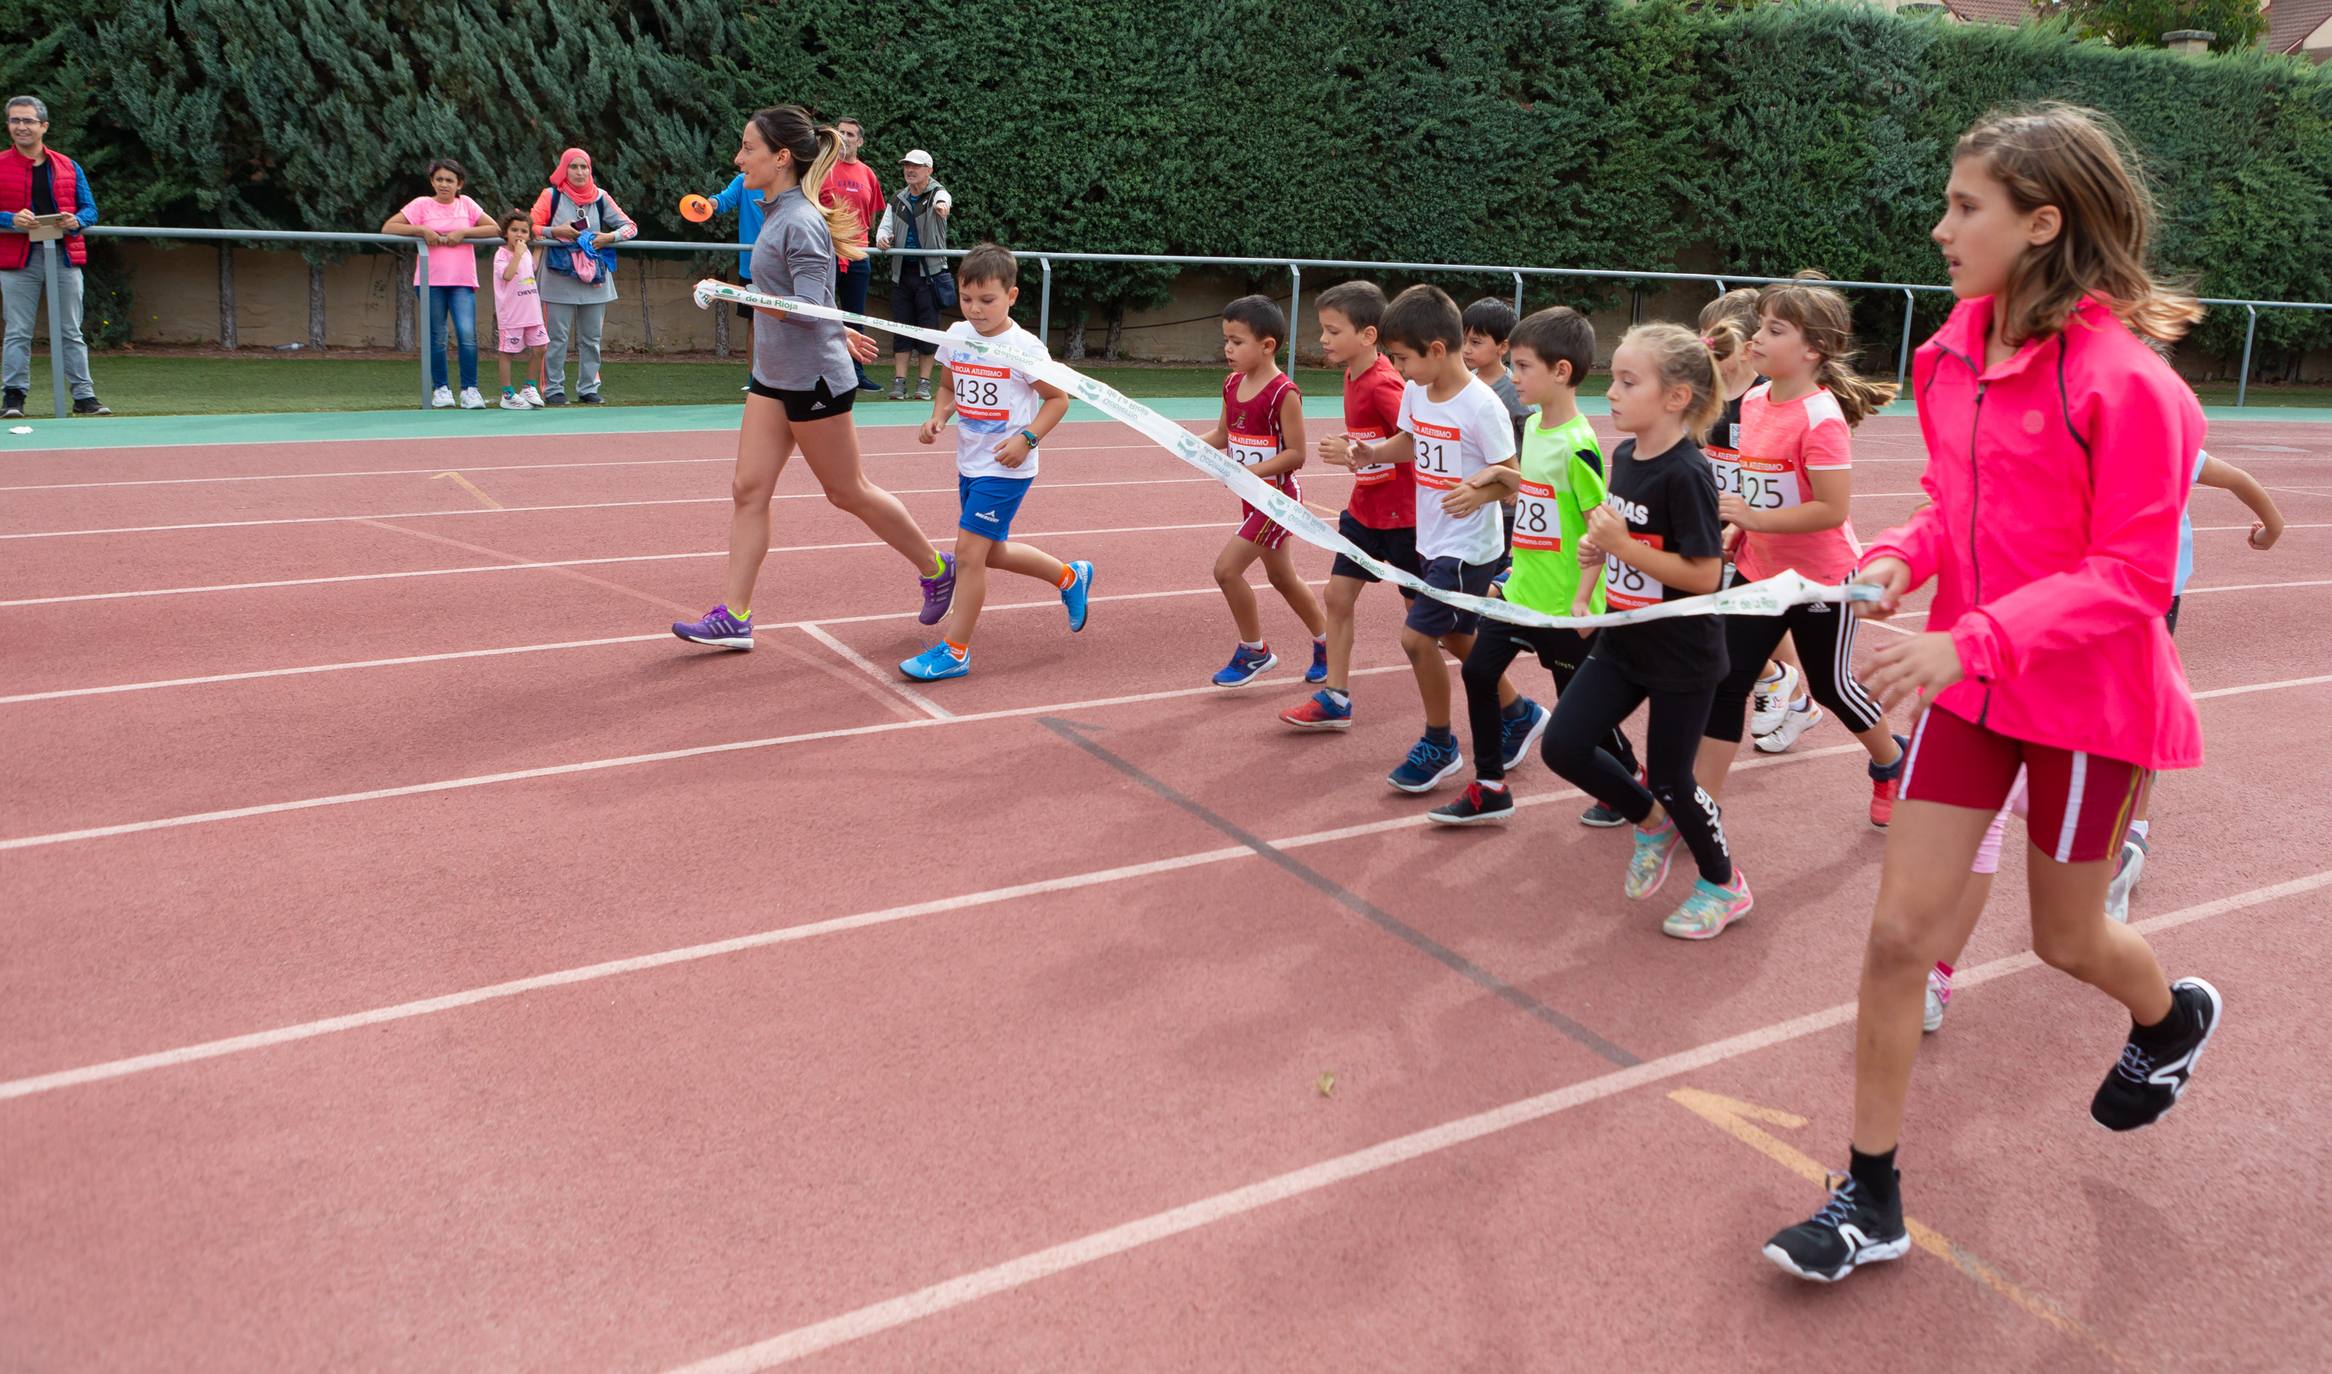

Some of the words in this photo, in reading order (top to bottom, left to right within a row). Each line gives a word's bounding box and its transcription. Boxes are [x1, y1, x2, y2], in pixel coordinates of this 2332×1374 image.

[760, 297, 773, 306] La
[774, 299, 799, 311] Rioja
[956, 378, 998, 406] 438
